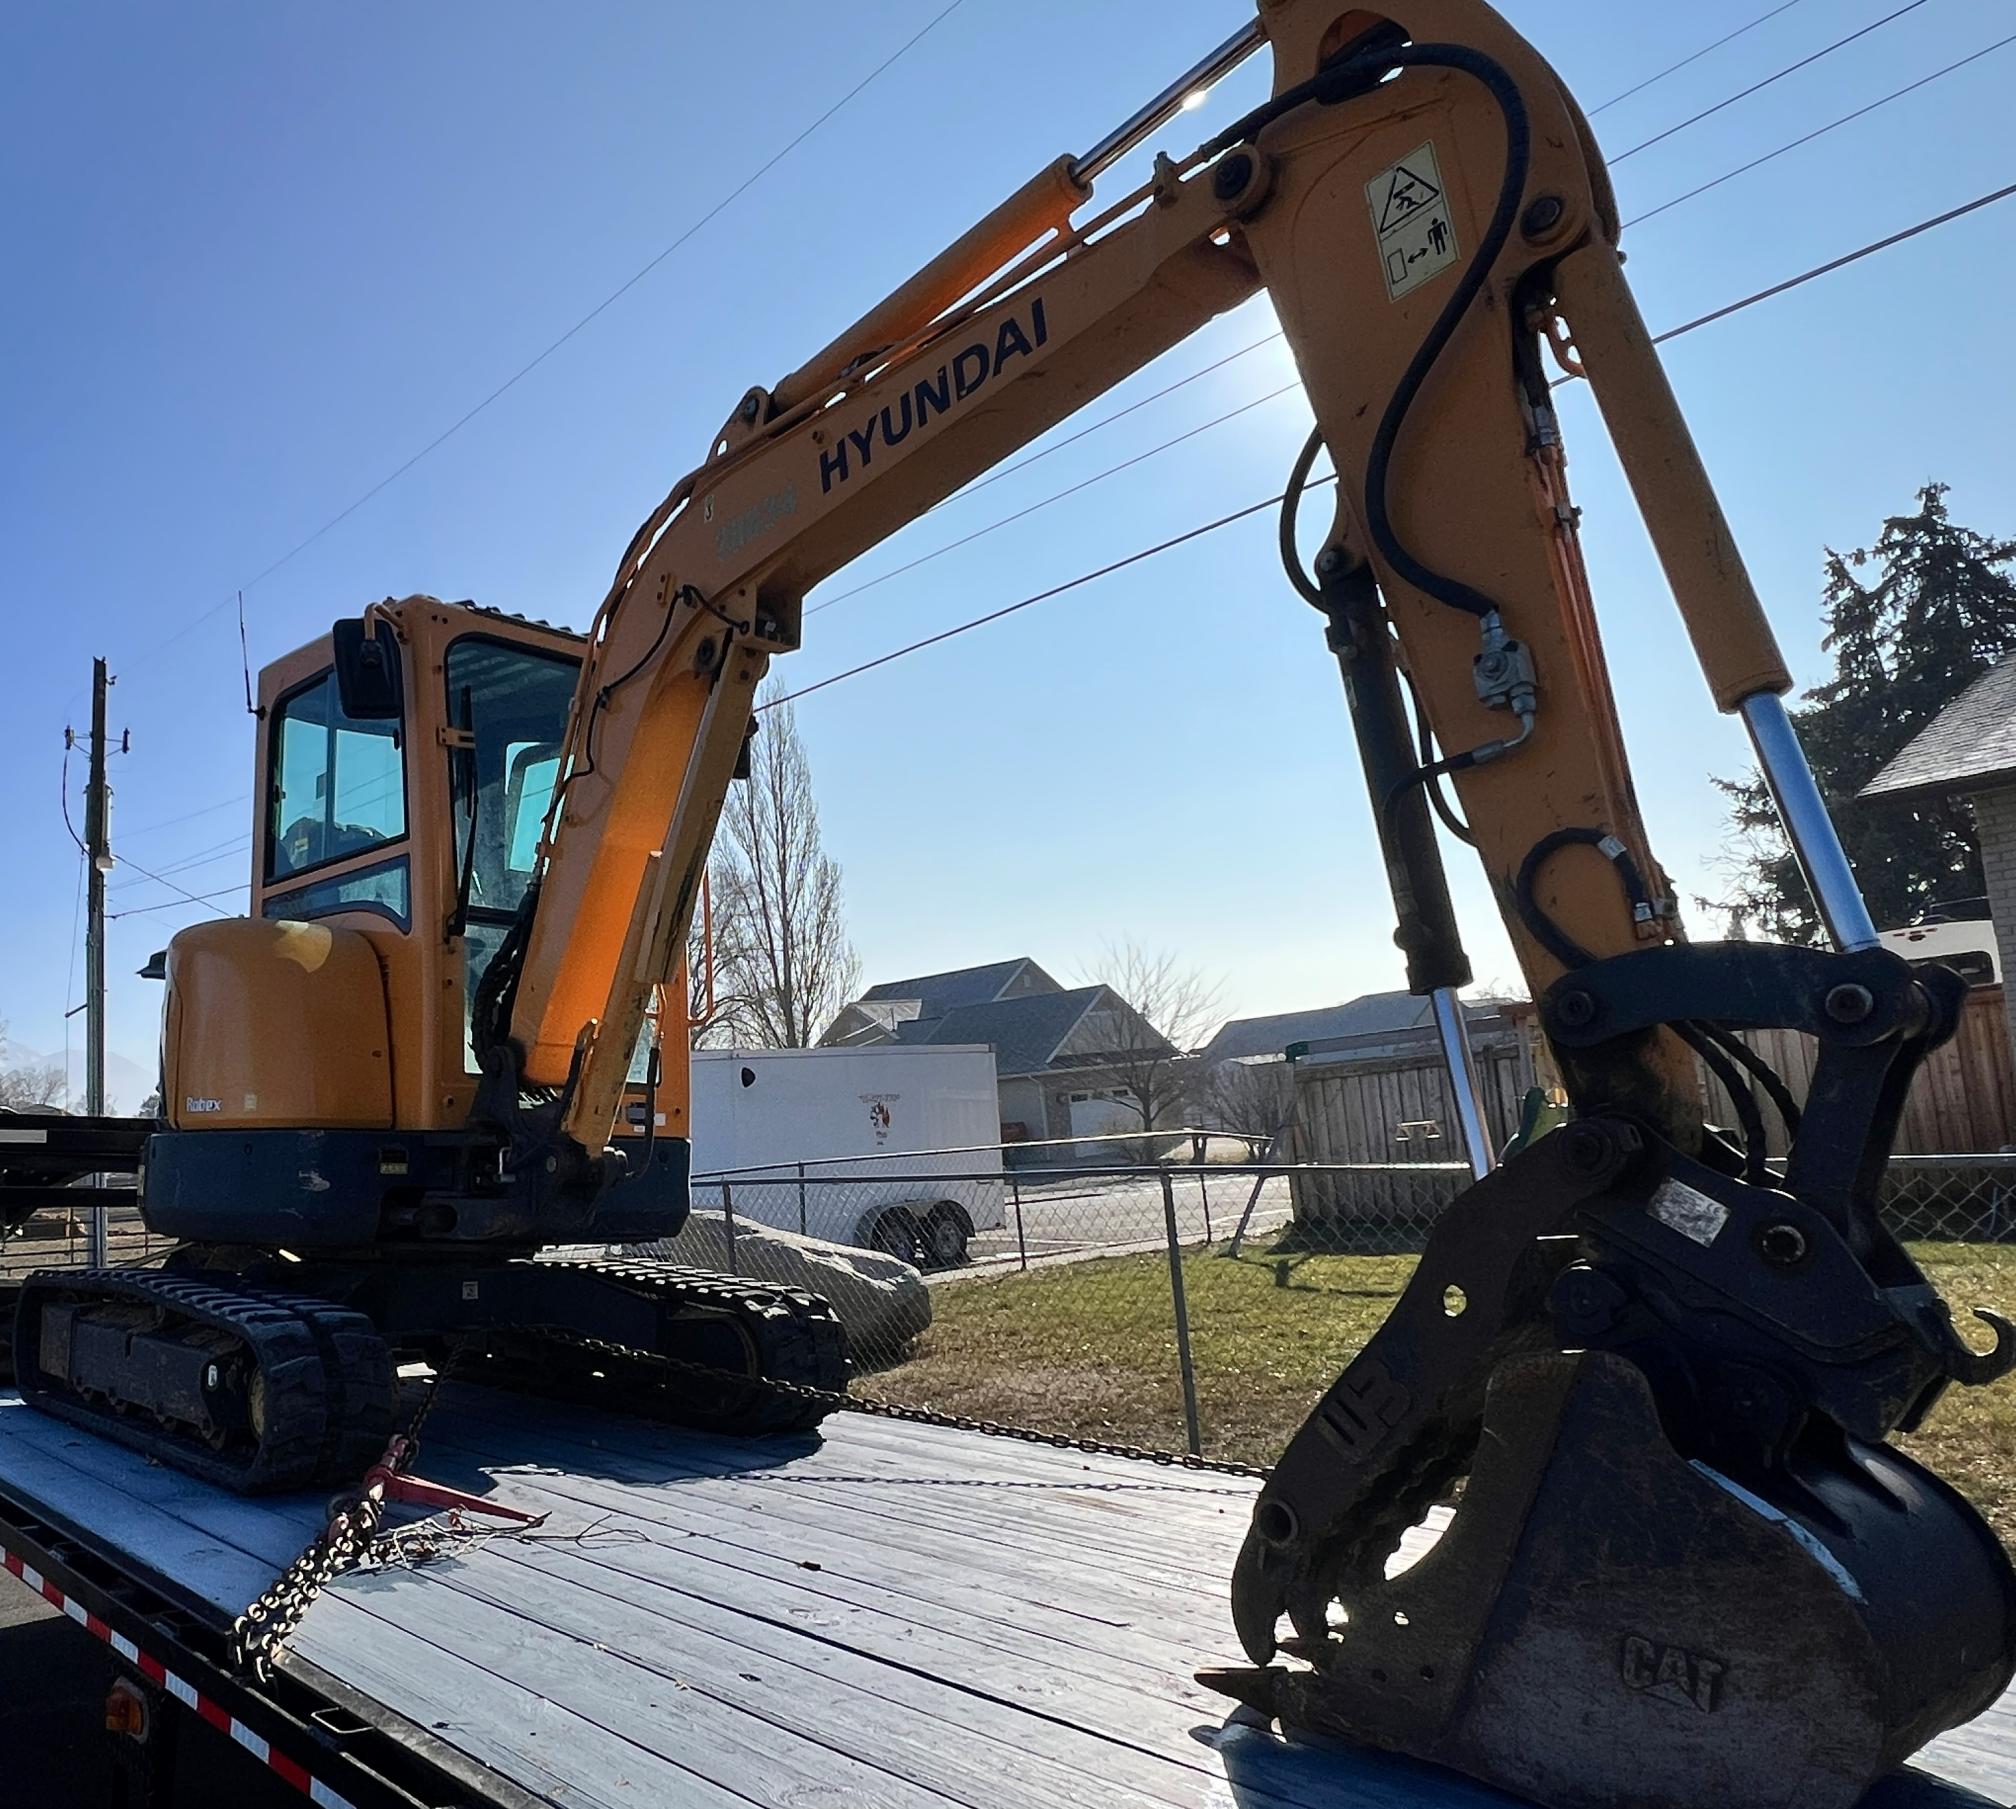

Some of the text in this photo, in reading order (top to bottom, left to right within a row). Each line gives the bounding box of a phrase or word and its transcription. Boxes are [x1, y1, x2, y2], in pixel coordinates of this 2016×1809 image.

[819, 297, 1047, 493] HYUNDAI
[186, 1096, 221, 1112] Robex
[1623, 1634, 1723, 1713] CAT
